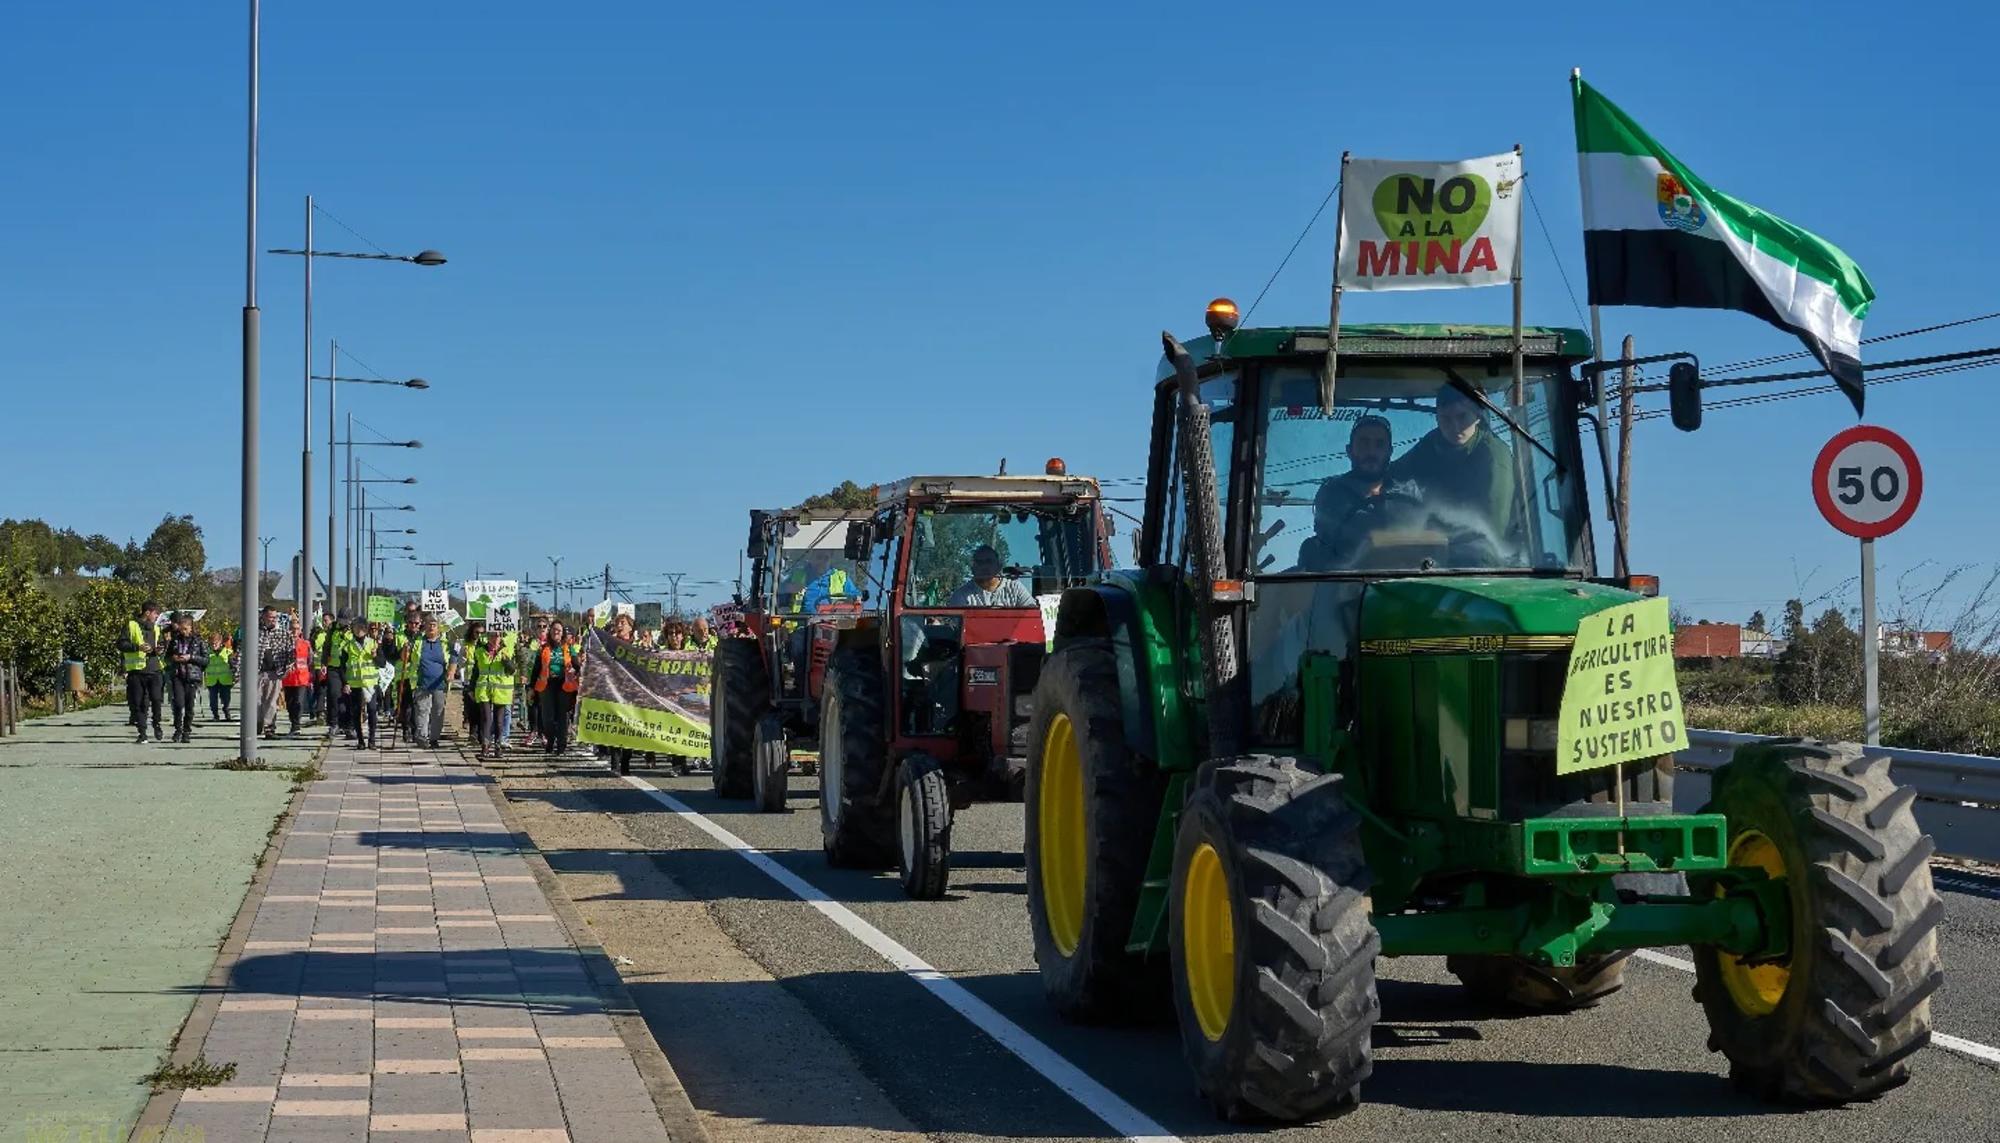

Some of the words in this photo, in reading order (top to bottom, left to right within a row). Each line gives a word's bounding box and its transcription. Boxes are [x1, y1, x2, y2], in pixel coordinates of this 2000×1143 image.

[1396, 176, 1477, 215] NO
[1399, 221, 1415, 237] A
[1424, 220, 1454, 237] LA
[1356, 236, 1498, 278] MINA
[1838, 466, 1899, 505] 50
[428, 590, 442, 598] NO
[493, 608, 511, 617] NO
[488, 622, 516, 632] MINA
[1606, 613, 1635, 637] LA
[1570, 634, 1668, 677] AGRICULTURA
[1604, 670, 1633, 695] ES
[1579, 690, 1673, 729] NUESTRO
[660, 734, 677, 744] LOS
[669, 726, 682, 735] LA
[1572, 720, 1677, 764] SUSTENTO
